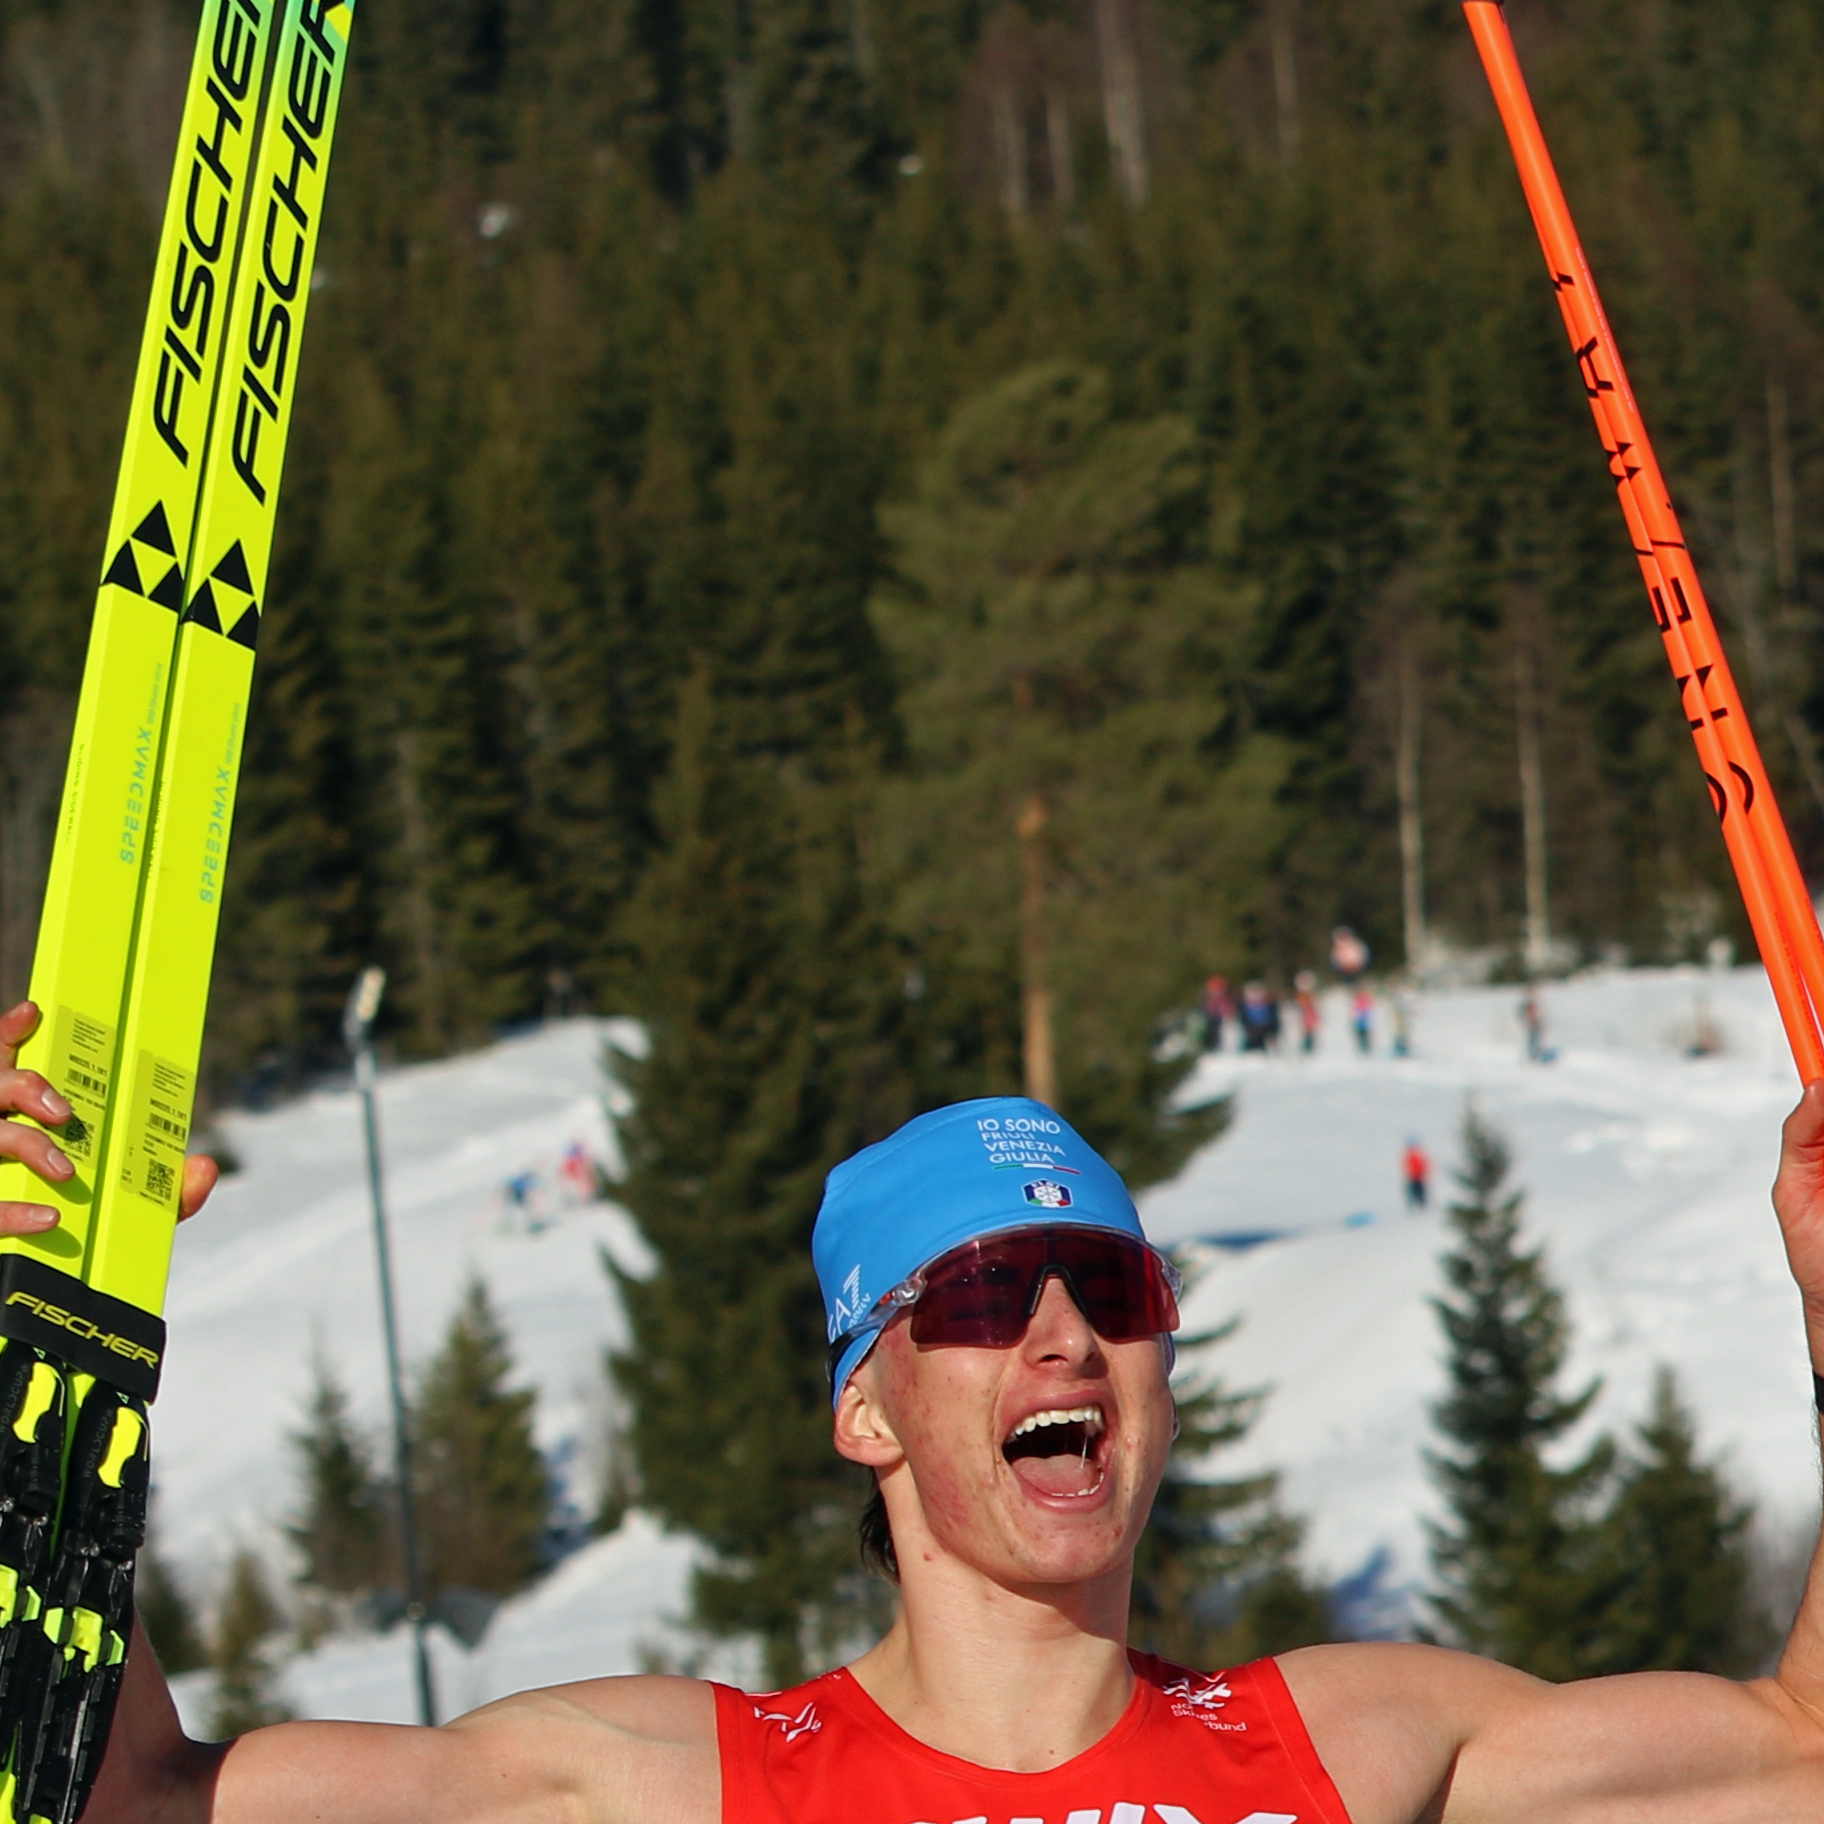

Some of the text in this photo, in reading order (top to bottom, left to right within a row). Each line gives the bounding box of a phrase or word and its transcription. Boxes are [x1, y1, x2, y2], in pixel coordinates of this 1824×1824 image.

[152, 0, 263, 468] FISCHE
[120, 726, 153, 866] SPEEDMAX
[199, 766, 232, 904] SPEEDMAX
[977, 1118, 1061, 1135] IO SONO
[984, 1140, 1066, 1157] VENEZIA
[989, 1153, 1055, 1165] GIULIA
[8, 1290, 160, 1371] FISCHER
